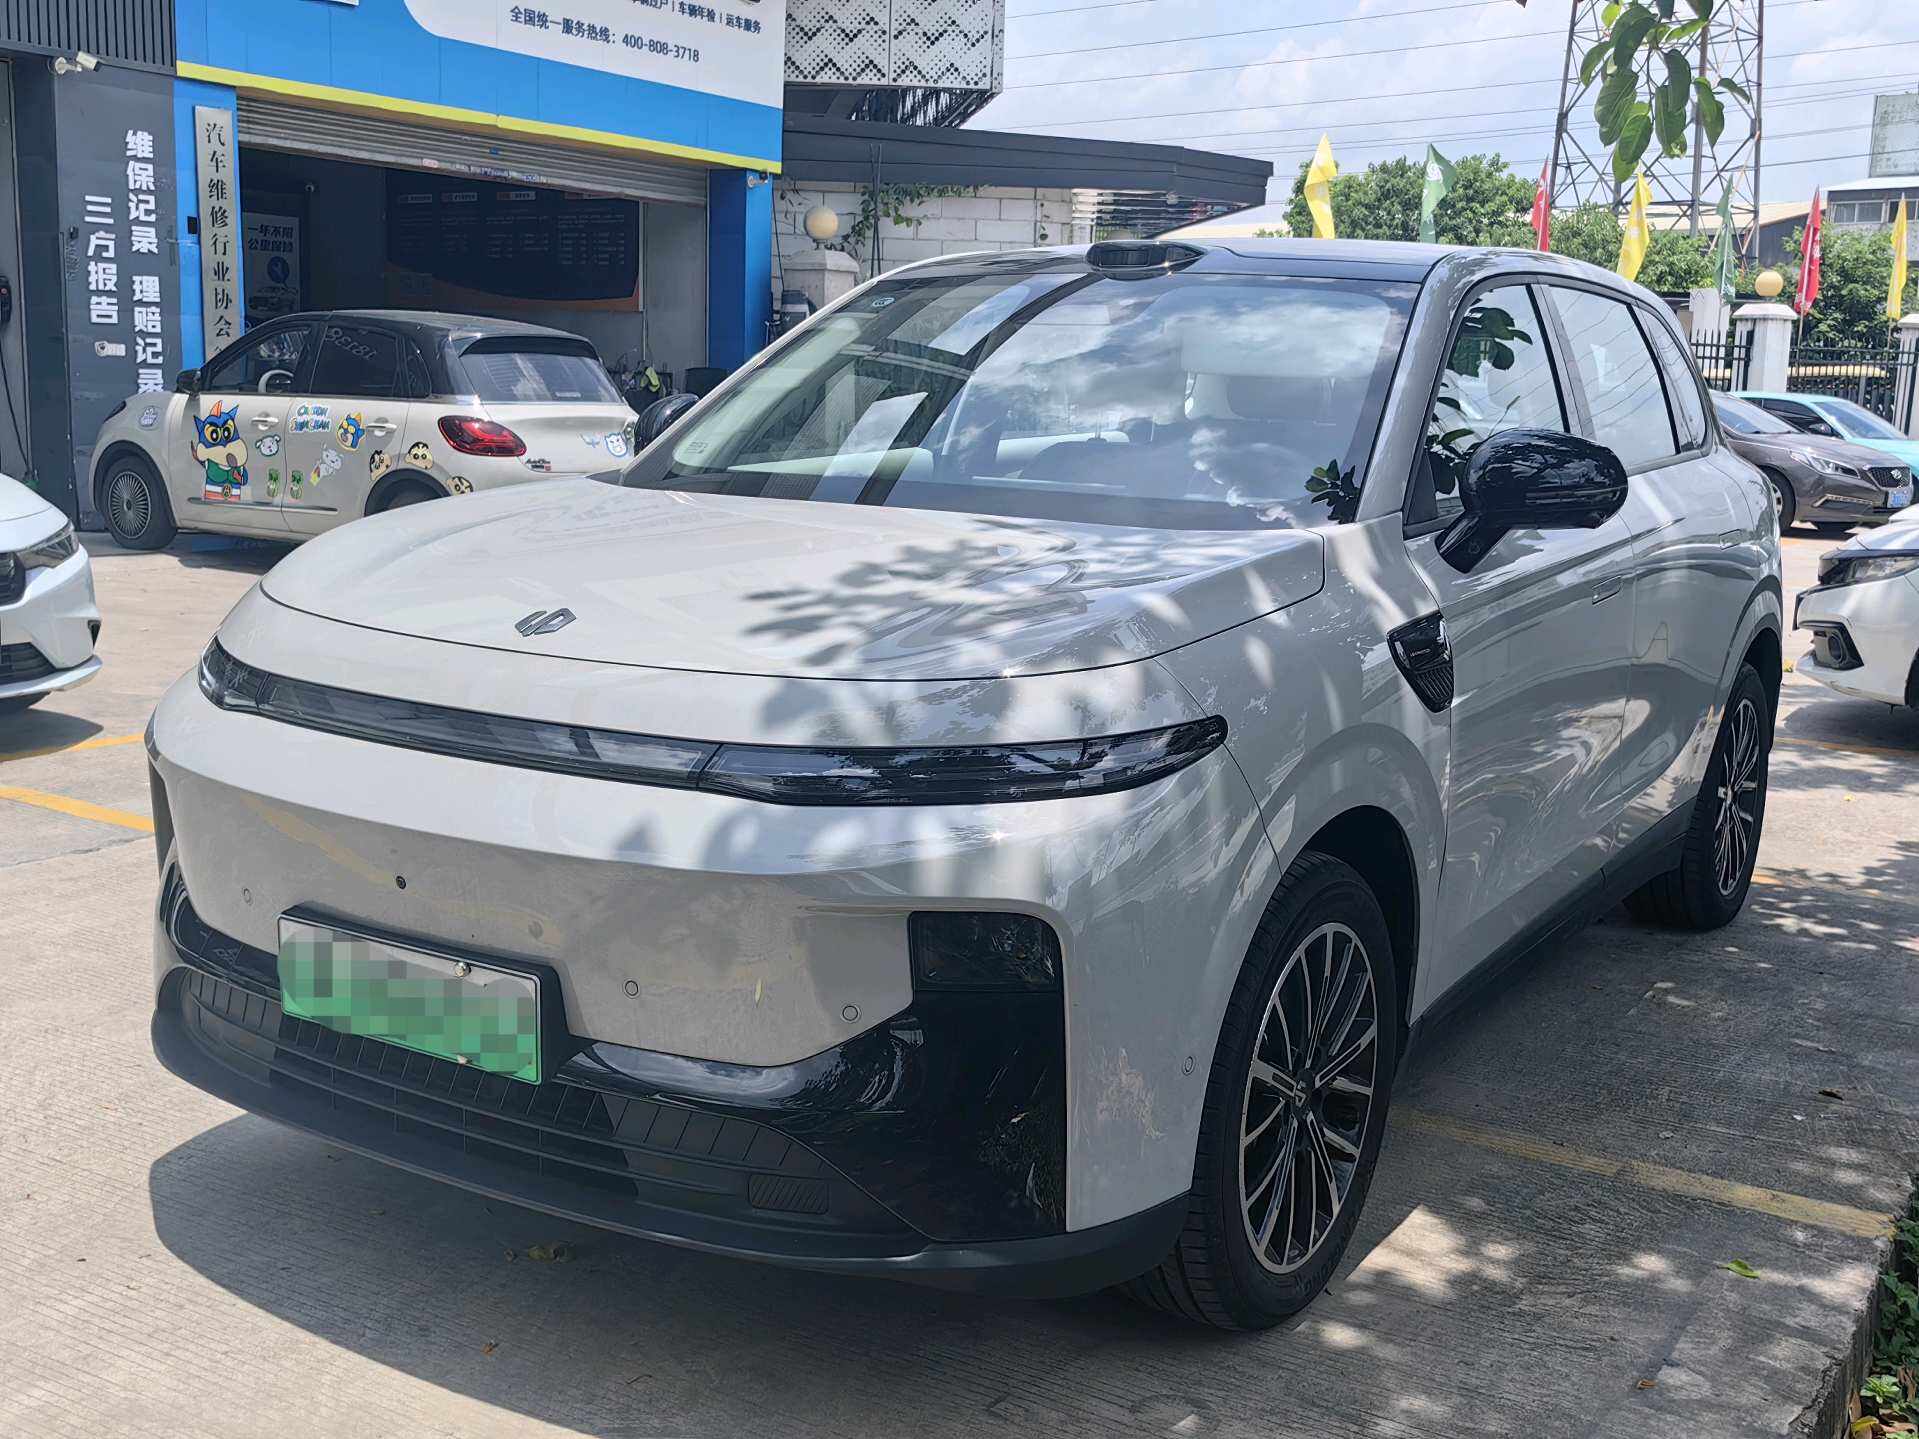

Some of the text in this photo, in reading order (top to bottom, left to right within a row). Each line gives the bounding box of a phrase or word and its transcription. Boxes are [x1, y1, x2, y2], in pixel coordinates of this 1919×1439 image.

[678, 1, 716, 23] 车辆年检
[725, 12, 761, 34] 运车服务
[84, 195, 119, 324] 三方报告
[125, 129, 164, 394] 维保记录 理赔记录
[205, 122, 233, 351] 汽车维修行业协会
